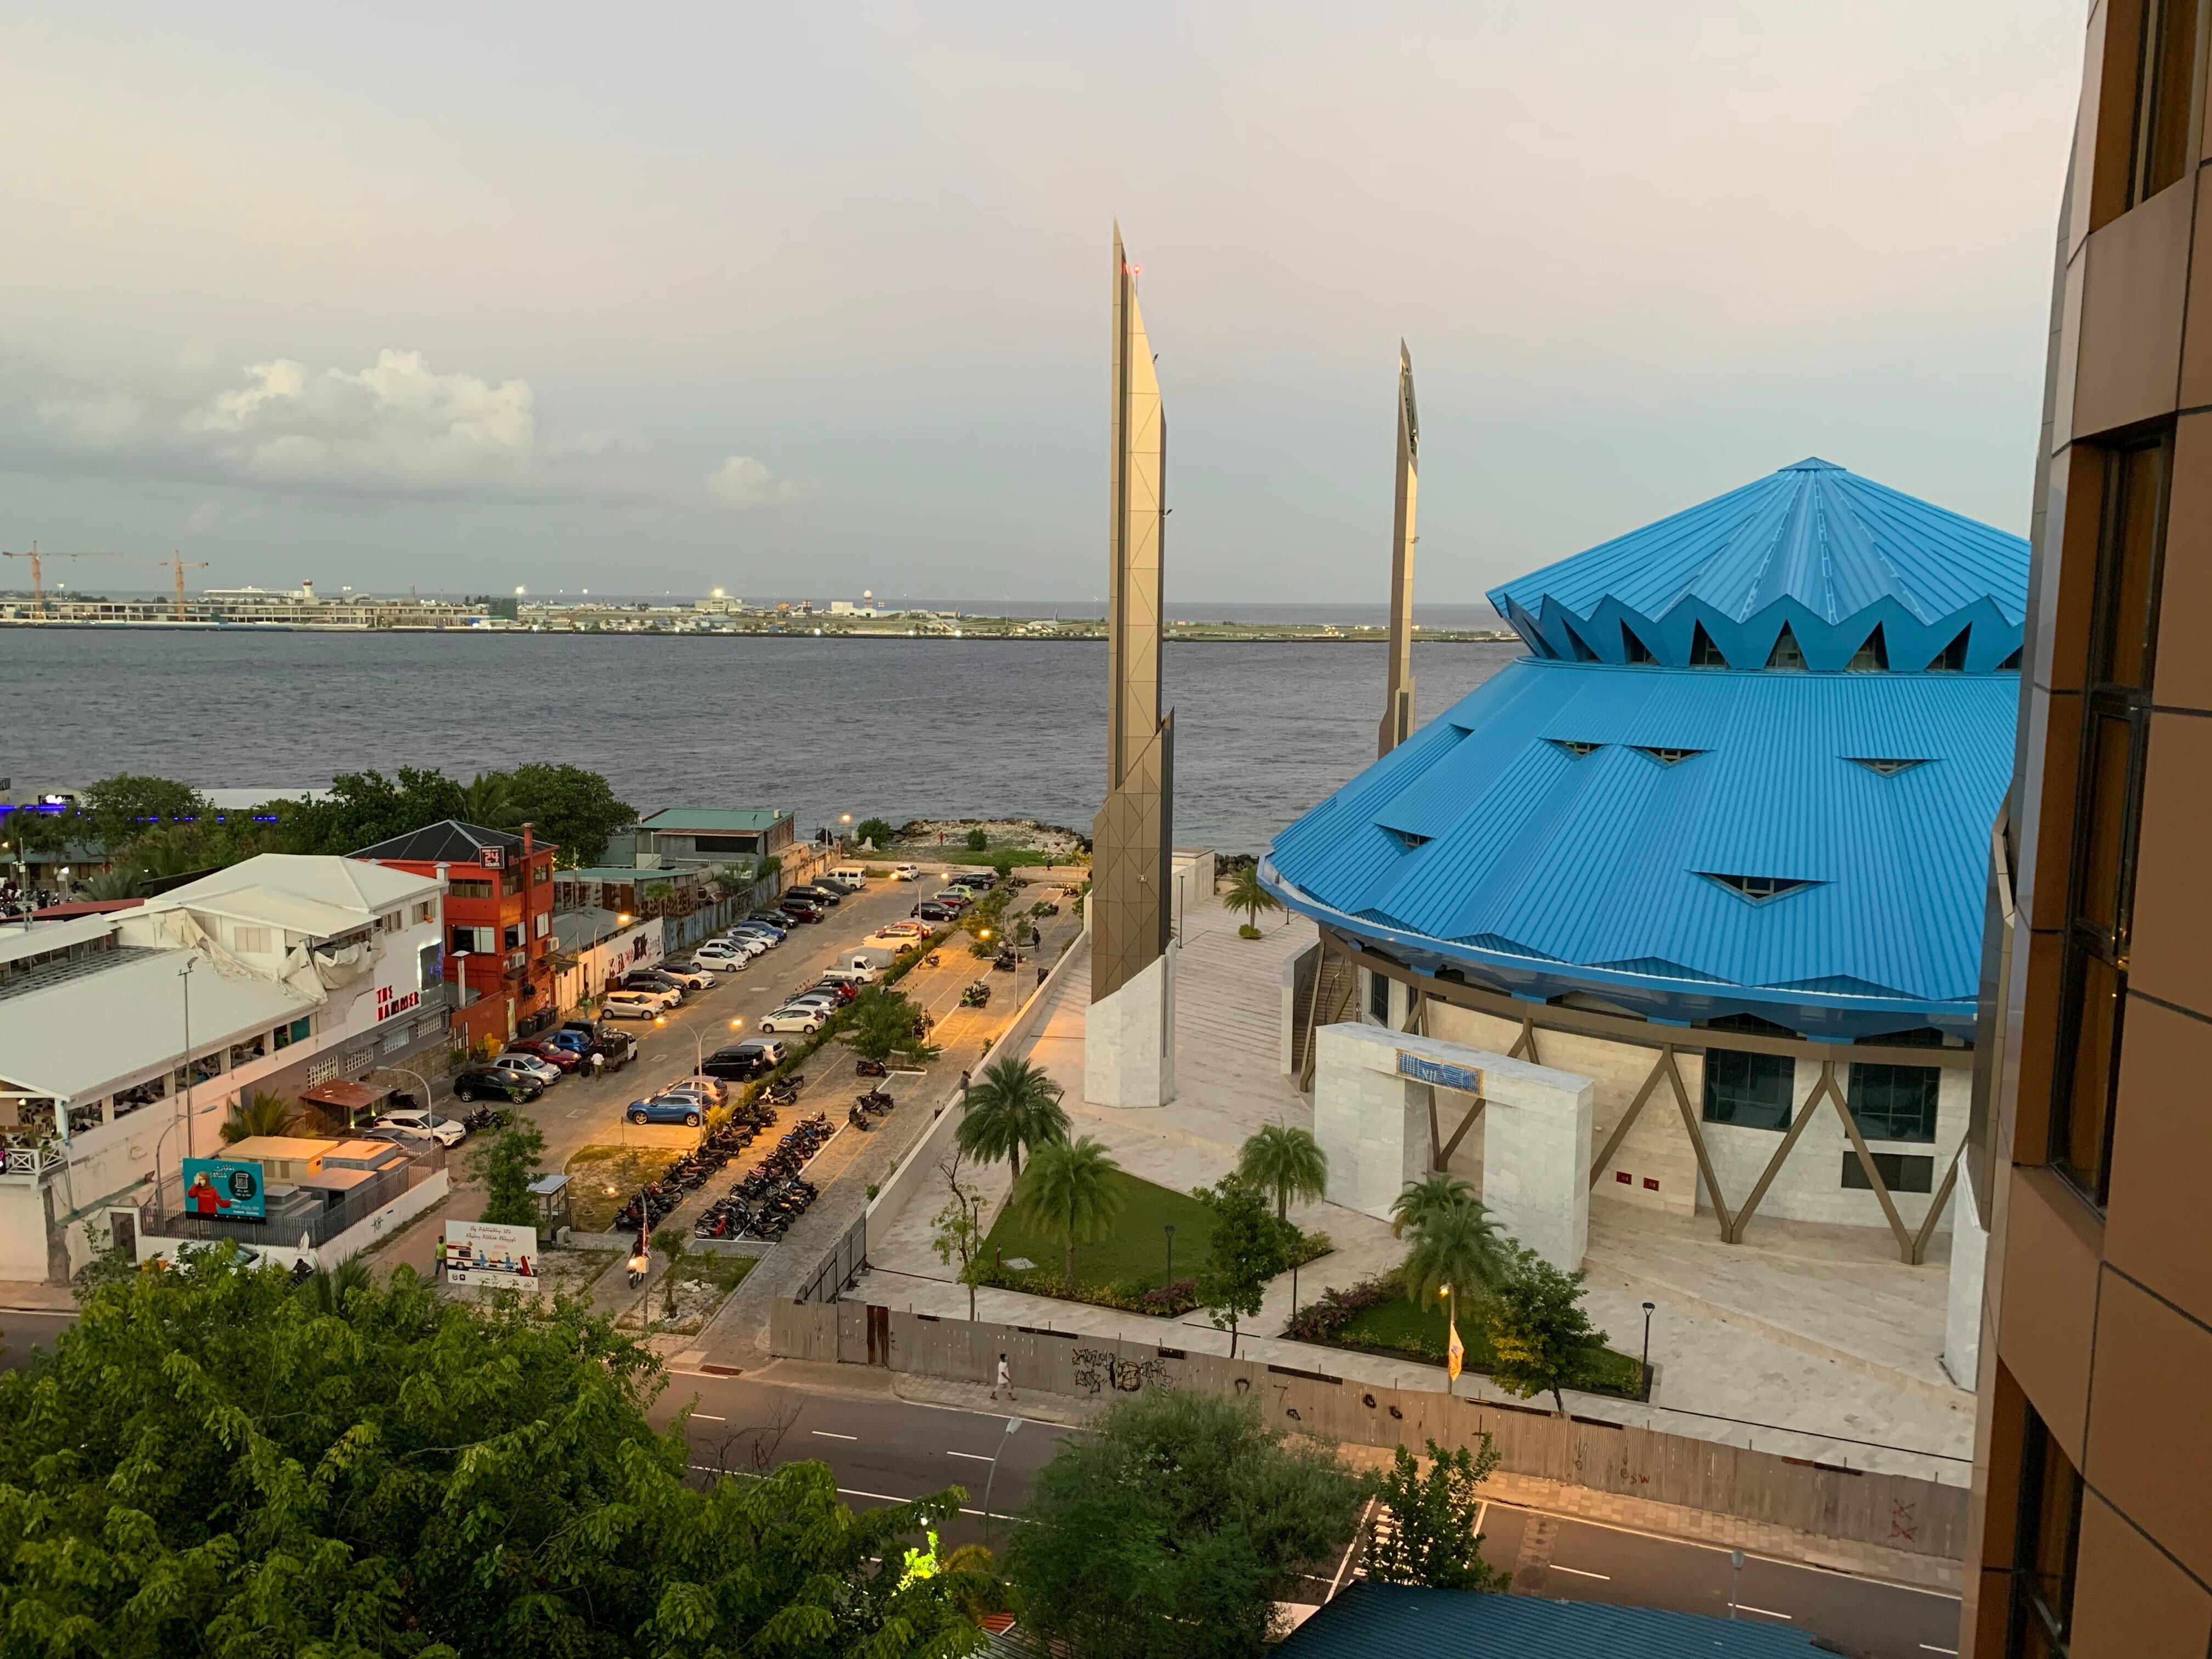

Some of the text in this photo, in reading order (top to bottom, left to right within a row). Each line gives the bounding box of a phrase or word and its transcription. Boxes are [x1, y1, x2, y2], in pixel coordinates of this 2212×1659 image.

[484, 852, 499, 862] 24
[376, 985, 393, 1004] THE
[378, 992, 419, 1021] HAMMER
